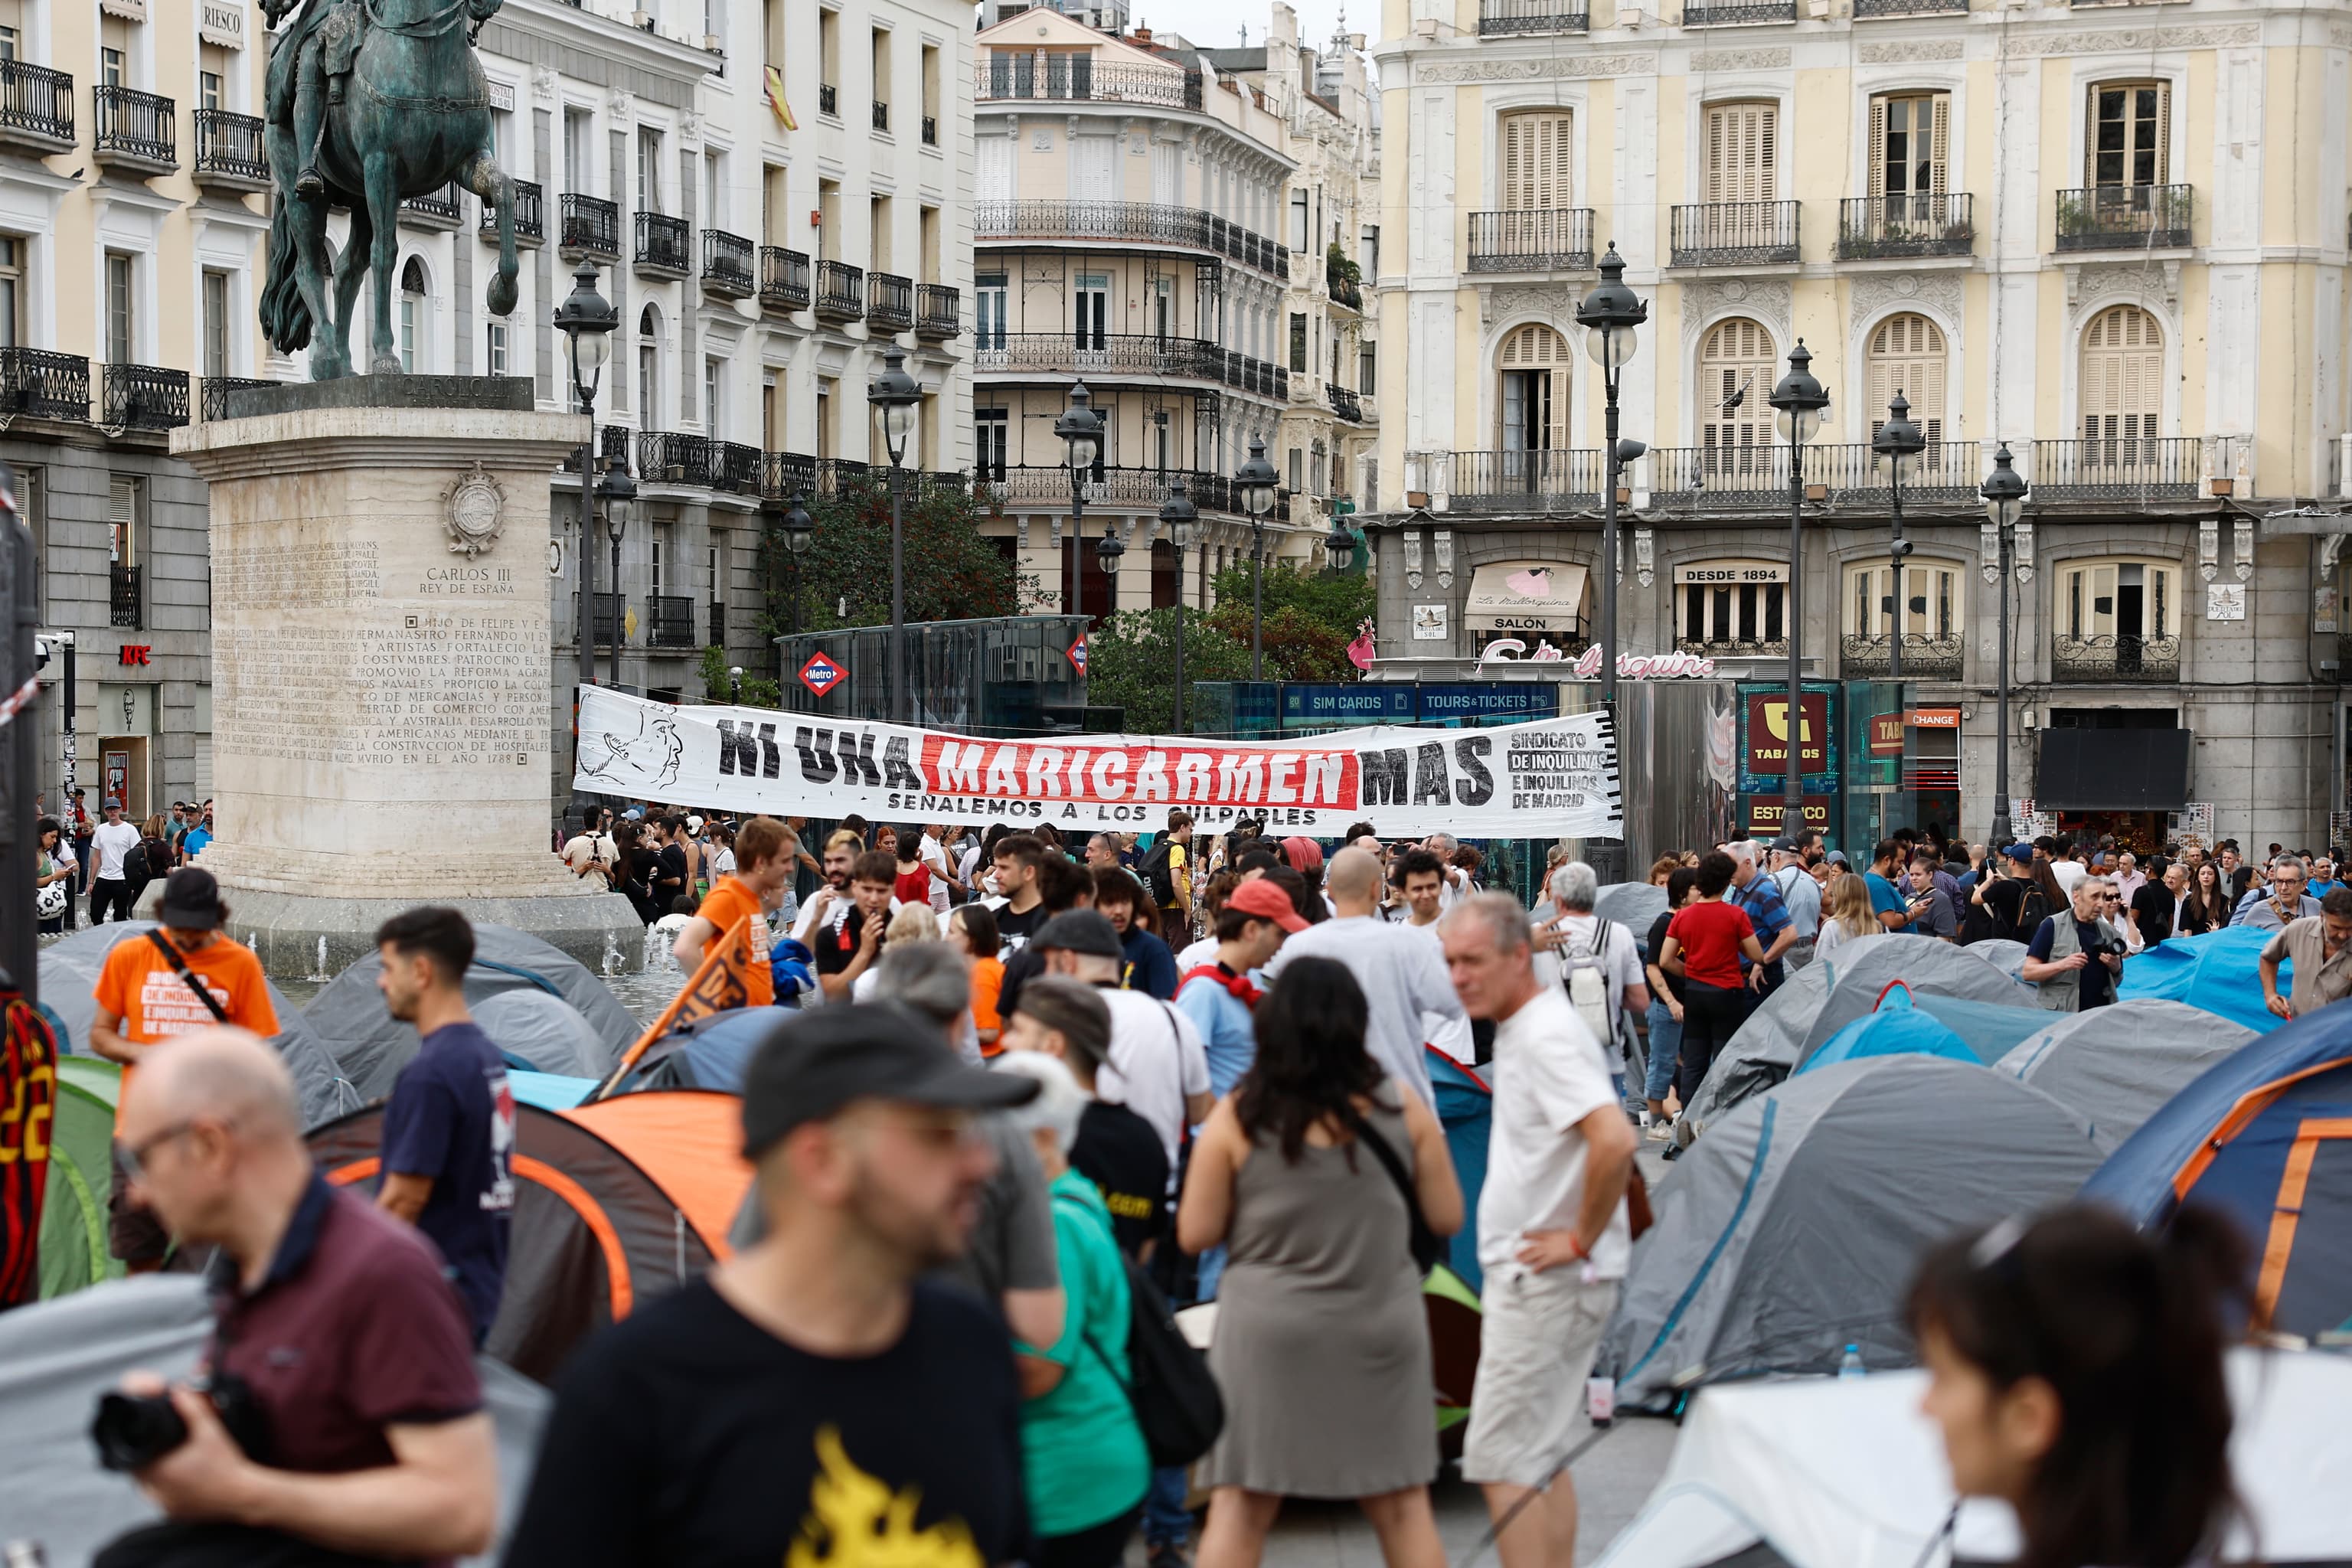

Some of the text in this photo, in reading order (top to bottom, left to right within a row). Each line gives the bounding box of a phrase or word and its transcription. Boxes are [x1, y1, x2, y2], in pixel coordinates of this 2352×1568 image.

[204, 6, 241, 34] RIESCO
[426, 567, 511, 581] CARLOS III
[1687, 570, 1777, 580] DESDE 1894
[420, 582, 514, 594] REY DE ESPAÑA
[1499, 596, 1572, 607] Mallorquina
[425, 618, 453, 628] HIJO
[462, 618, 474, 628] DE
[482, 619, 514, 629] FELIPE
[521, 619, 528, 629] V
[534, 619, 539, 629] E
[1494, 616, 1546, 629] SALÓN
[357, 630, 447, 641] HERMANASTRO
[455, 631, 517, 642] FERNANDO
[525, 632, 534, 642] VI
[539, 632, 548, 642] EN
[362, 642, 368, 652] Y
[447, 643, 526, 653] FORTALECIO
[533, 645, 545, 654] LA
[121, 645, 152, 665] KFC
[457, 655, 519, 665] PATROCINO
[525, 656, 534, 665] EL
[356, 667, 421, 678] PROMOVIO
[430, 668, 446, 677] LA
[455, 668, 510, 677] REFORMA
[808, 669, 833, 681] Metro
[443, 680, 499, 690] PROPICIO
[505, 681, 518, 690] LA
[384, 691, 400, 701] DE
[408, 691, 484, 702] MERCANCIAS
[493, 692, 499, 702] Y
[410, 704, 425, 714] DE
[433, 704, 497, 714] COMERCIO
[503, 705, 524, 714] CON
[1313, 696, 1382, 710] SIM CARDS
[389, 717, 396, 726] Y
[470, 717, 534, 727] DESARROLLO
[1913, 714, 1955, 725] CHANGE
[364, 729, 369, 739] Y
[377, 729, 456, 739] AMERICANAS
[464, 730, 519, 740] MEDIANTE
[524, 730, 534, 740] EL
[356, 742, 365, 751] LA
[373, 741, 464, 751] CONSTRVCCION
[471, 742, 486, 751] DE
[494, 742, 548, 752] HOSPITALES
[1511, 732, 1587, 750] SINDICATO
[357, 754, 394, 764] MVRIO
[403, 754, 417, 764] EN
[426, 754, 441, 764] EL
[452, 751, 478, 764] AÑO
[488, 754, 511, 764] 1788
[1755, 748, 1820, 760] TABAOS
[716, 719, 1494, 806] NI UNA MARICARMEN MAS
[1511, 754, 1530, 769] DE
[1512, 775, 1598, 792] E INQUILINOS
[1512, 792, 1586, 809] DE MADRID
[1060, 802, 1079, 818] A
[1098, 804, 1147, 822] LOS
[1168, 805, 1318, 826] ULPABLES
